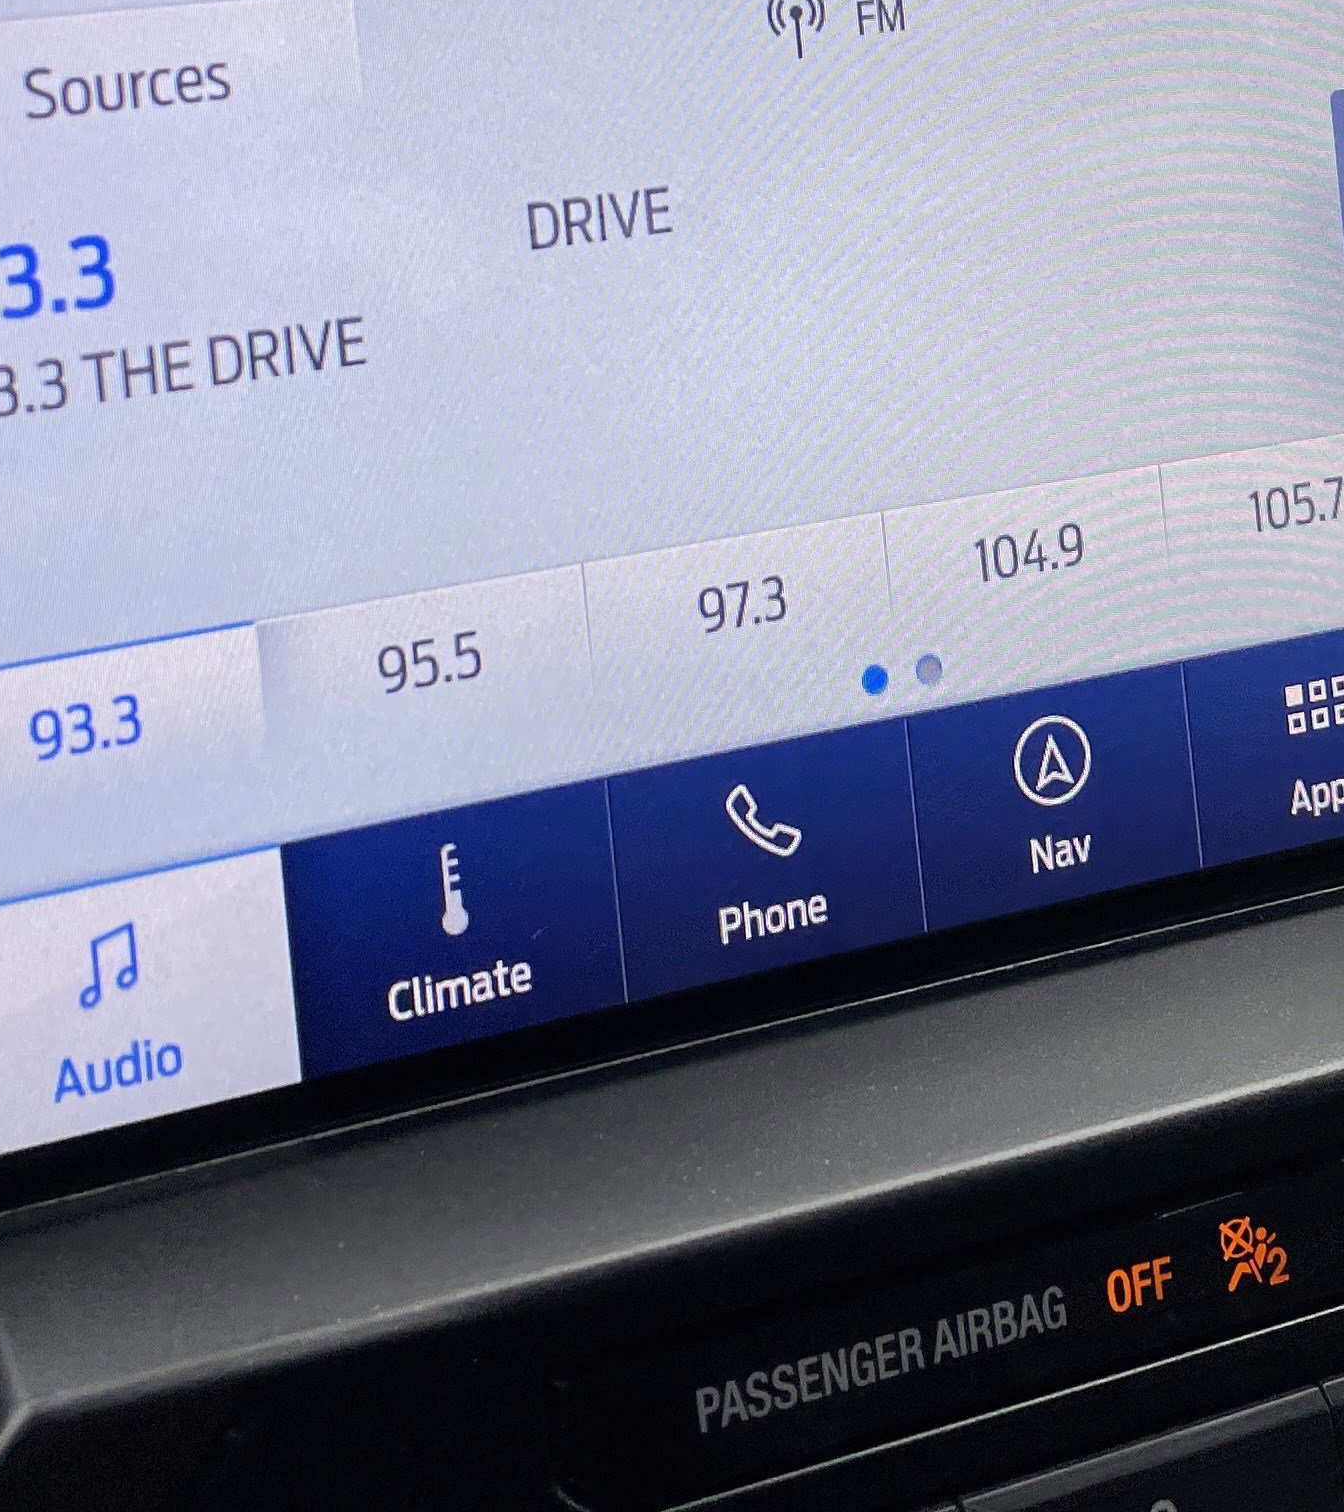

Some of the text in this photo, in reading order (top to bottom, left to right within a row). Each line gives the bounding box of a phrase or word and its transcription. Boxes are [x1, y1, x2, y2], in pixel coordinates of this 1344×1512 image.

[23, 61, 232, 120] Sources
[527, 186, 674, 250] DRIVE
[82, 340, 195, 403] THE
[208, 316, 368, 386] DRIVE
[1248, 476, 1344, 532] 105.7
[973, 522, 1085, 582] 104.9
[697, 574, 789, 634] 97.3
[377, 630, 484, 694] 95.5
[29, 694, 144, 761] 93.3
[1028, 832, 1093, 875] Nav
[718, 893, 829, 946] Phone
[387, 959, 534, 1023] Climate
[54, 1040, 184, 1104] Audio
[695, 1327, 926, 1434] PASSENGER
[933, 1285, 1068, 1366] AIRBAG
[1106, 1256, 1173, 1313] OFF
